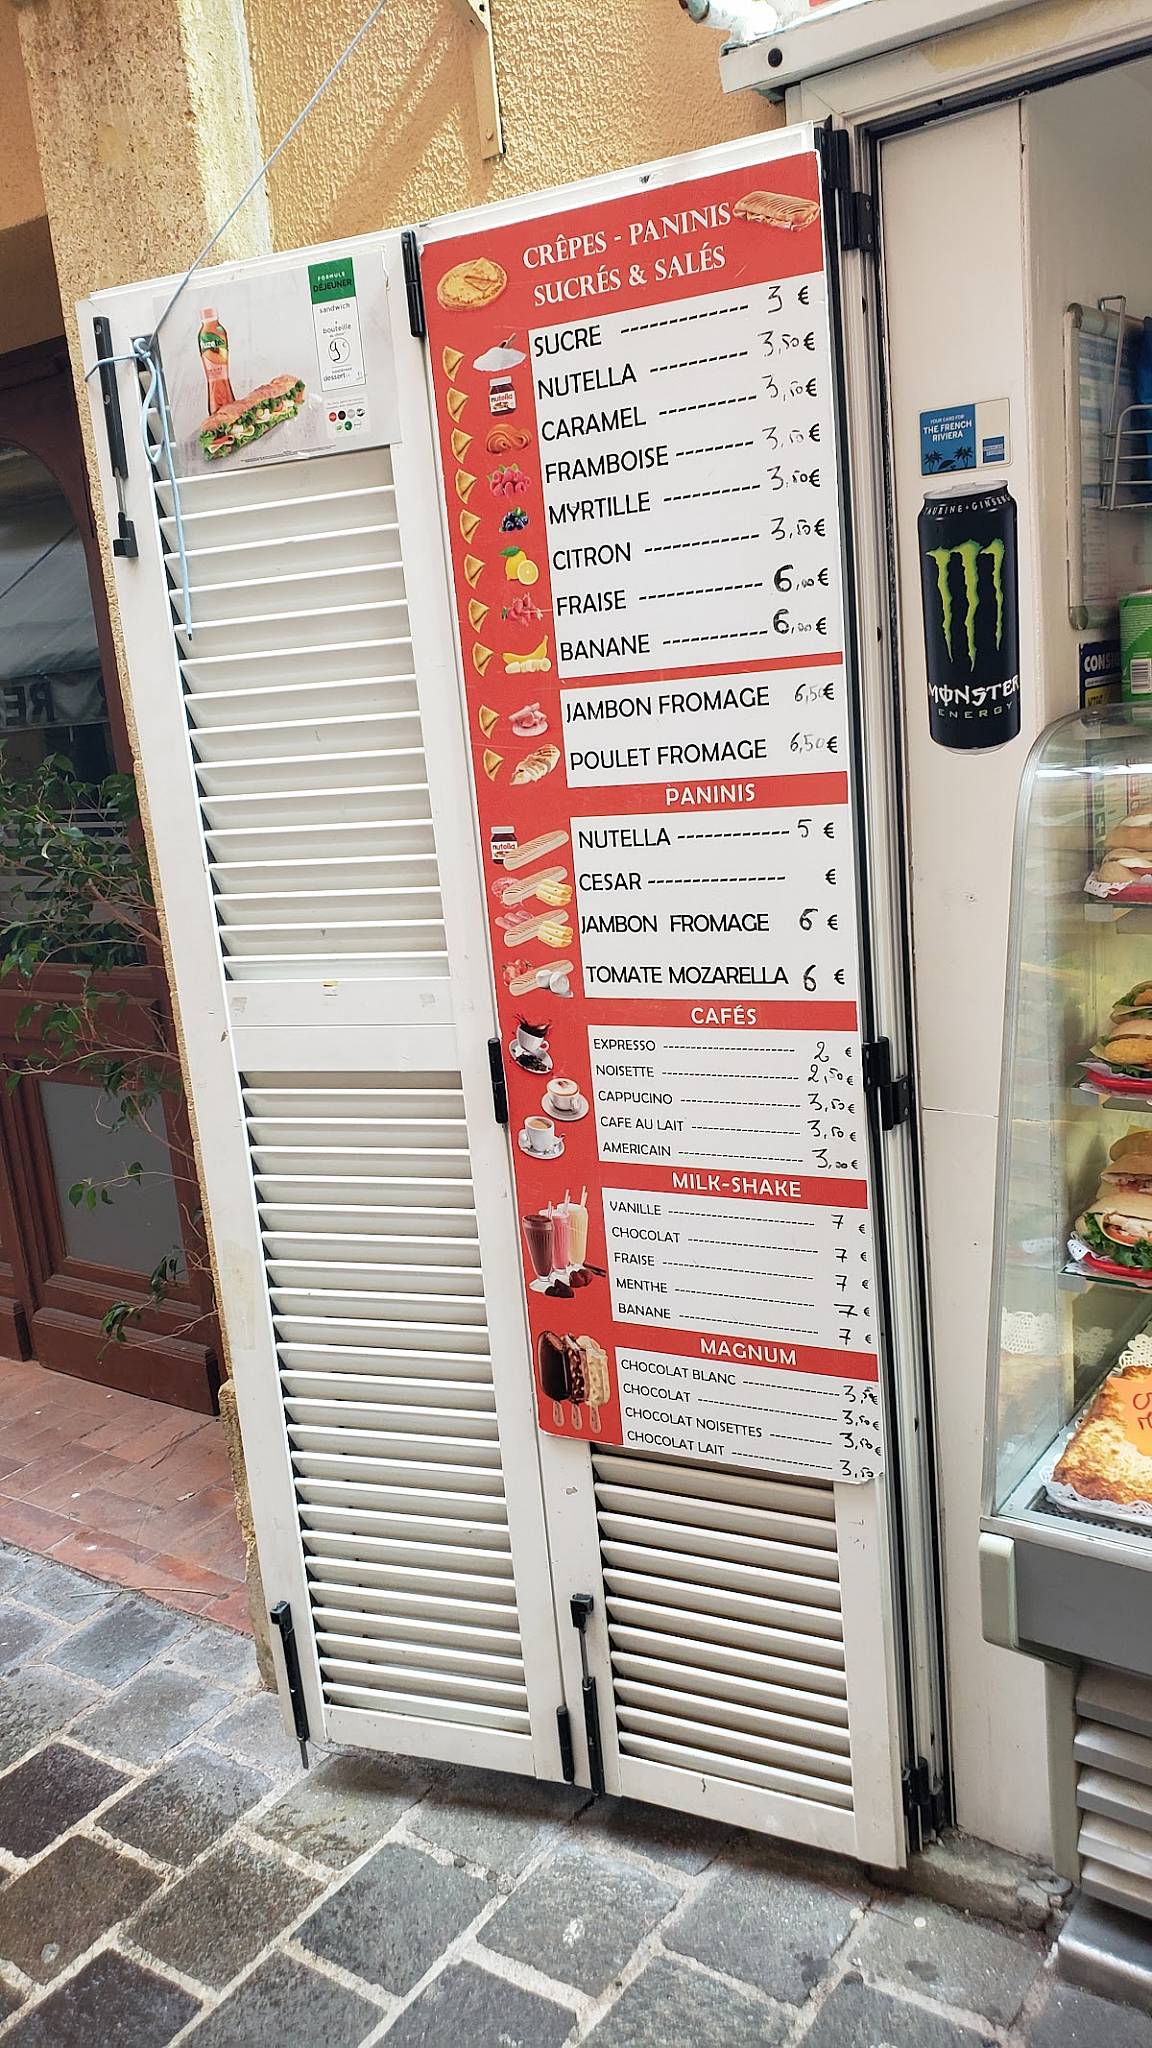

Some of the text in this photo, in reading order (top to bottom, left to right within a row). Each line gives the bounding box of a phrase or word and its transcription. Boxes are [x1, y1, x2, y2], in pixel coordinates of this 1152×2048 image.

[523, 231, 607, 269] CRÊPES
[629, 203, 731, 246] PANINIS
[313, 279, 352, 292] DÉJEUNER
[533, 242, 726, 307] SUCRÉS & SALÉS
[320, 303, 350, 313] sandwich
[534, 325, 602, 357] SUCRE
[768, 285, 782, 314] 3
[323, 323, 351, 334] bouteille
[537, 363, 637, 400] NUTELLA
[541, 406, 647, 442] CARAMEL
[923, 420, 972, 434] THE FRENCH
[933, 431, 963, 442] RIVIERA
[545, 445, 669, 484] FRAMBOISE
[549, 492, 651, 525] MYRTILLE
[553, 542, 632, 571] CITRON
[557, 590, 627, 616] FRAISE
[560, 634, 651, 661] BANANE
[566, 697, 652, 724] JAMBON
[658, 686, 770, 715] FROMAGE
[938, 702, 1013, 719] ENERGY
[570, 748, 650, 771] POULET
[657, 739, 767, 765] FROMAGE
[665, 783, 756, 806] PANINIS
[578, 819, 835, 849] NUTELLA 5 €
[579, 868, 837, 891] CESAR €
[582, 908, 838, 934] JAMBON FROMAGE 6 €
[586, 964, 845, 991] TOMATE MOZARELLA 6 €
[691, 1004, 757, 1026] CAFÉS
[593, 1039, 656, 1051] EXPRESSO
[814, 1041, 829, 1062] 2
[596, 1064, 654, 1078] NOISETTE
[598, 1091, 673, 1105] CAPPUCINO
[600, 1116, 632, 1128] CAFE
[635, 1118, 653, 1129] AU
[657, 1119, 684, 1131] LAIT
[603, 1142, 671, 1156] AMERICAIN
[672, 1172, 801, 1198] MILK-SHAKE
[609, 1200, 662, 1216] VANILLE
[831, 1214, 844, 1229] 7
[612, 1226, 680, 1243] CHOCOLAT
[835, 1248, 847, 1263] 7
[614, 1252, 655, 1266] FRAISE
[835, 1275, 847, 1292] 7
[616, 1278, 668, 1293] MENTHE
[834, 1303, 858, 1318] 7
[618, 1302, 671, 1319] BANANE
[839, 1328, 850, 1345] 7
[700, 1338, 796, 1365] MAGNUM
[621, 1359, 688, 1379] CHOCOLAT
[692, 1369, 736, 1385] BLANC
[623, 1383, 690, 1402] CHOCOLAT
[625, 1407, 692, 1427] CHOCOLAT
[696, 1417, 763, 1438] NOISETTES
[627, 1430, 694, 1450] CHOCOLAT
[697, 1441, 725, 1456] LAIT
